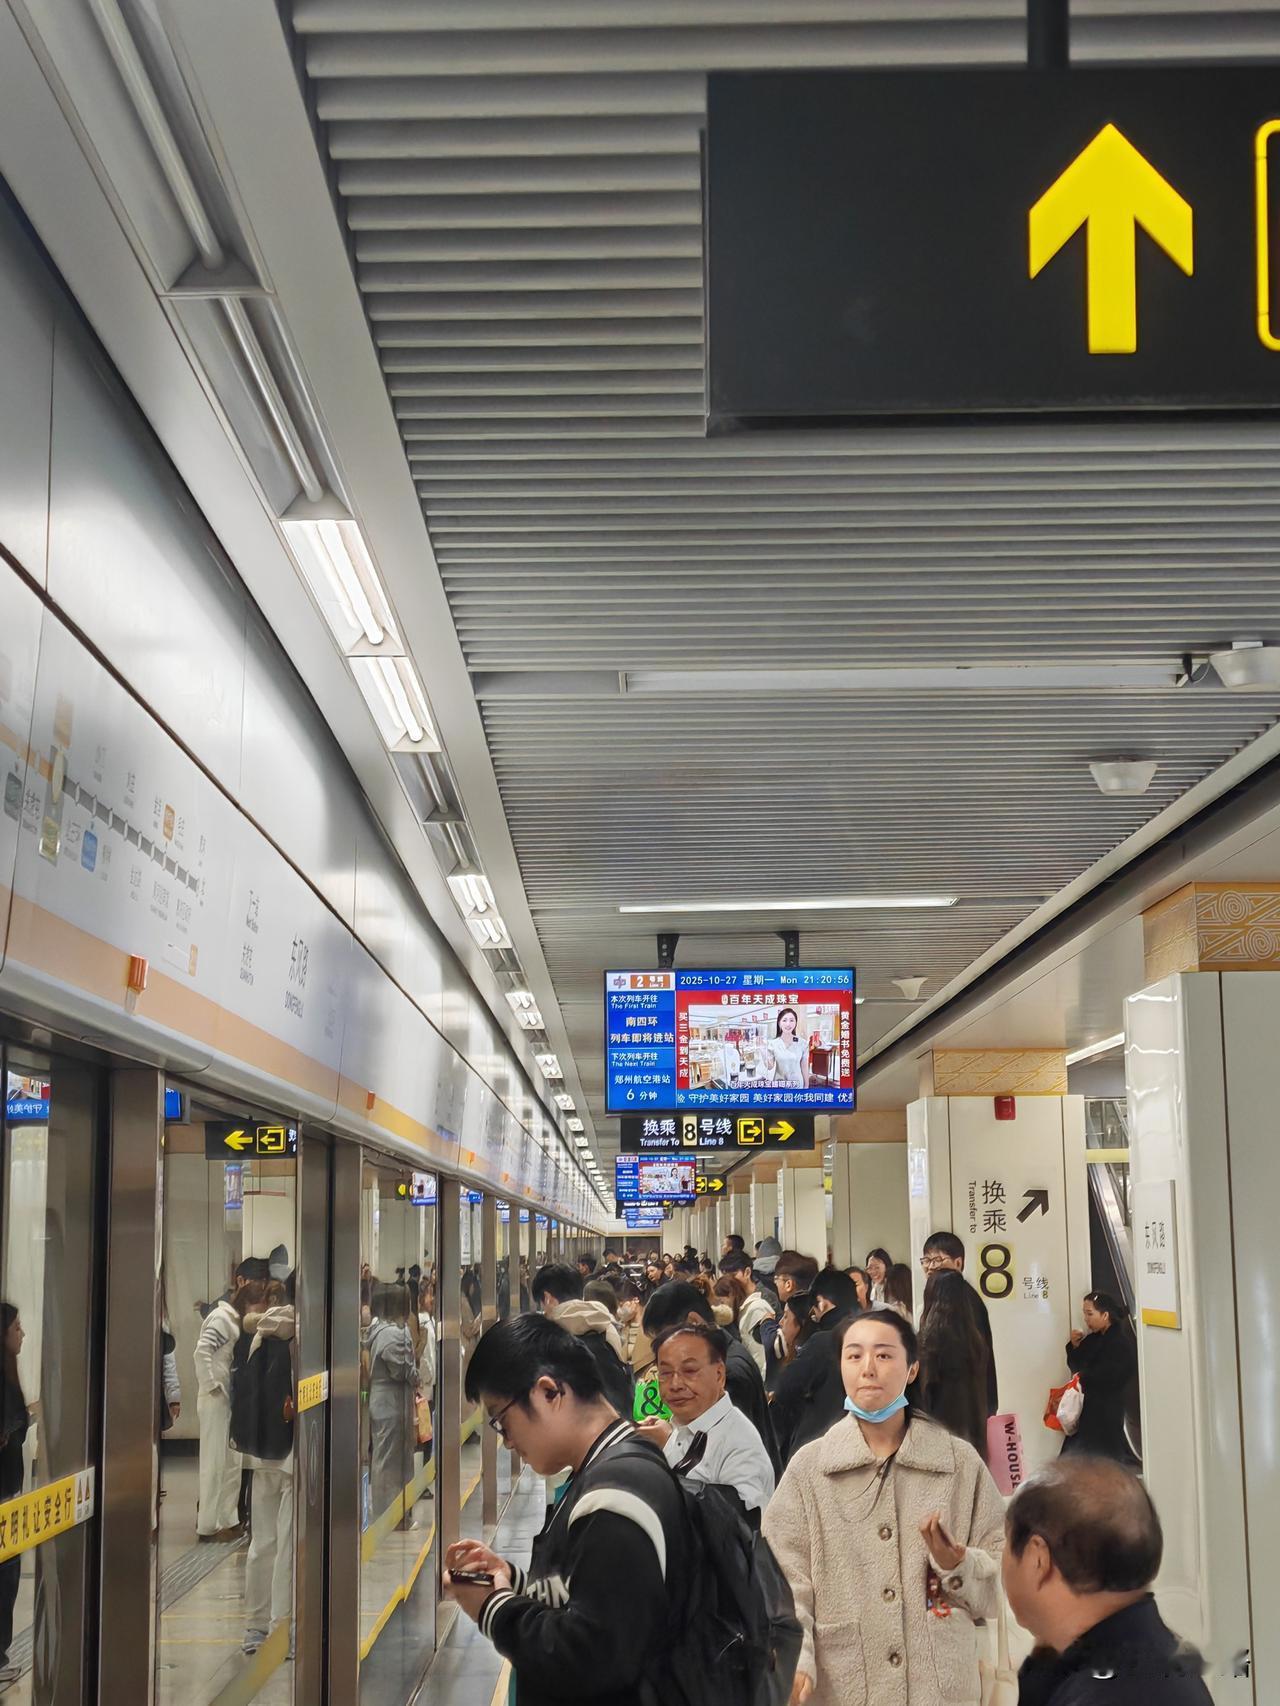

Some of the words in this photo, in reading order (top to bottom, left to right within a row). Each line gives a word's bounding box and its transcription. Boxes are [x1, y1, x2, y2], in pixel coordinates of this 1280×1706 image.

[637, 976, 644, 988] 2
[681, 976, 737, 985] 2025-10-27
[742, 975, 775, 986] 星期一
[780, 976, 798, 984] Mon
[804, 975, 850, 984] 21:20:56
[611, 994, 658, 1003] 本次列车开往
[625, 1016, 658, 1027] 南四环
[610, 1033, 674, 1044] 列车即将进站
[611, 1052, 658, 1061] 下次列车开往
[614, 1074, 671, 1084] 郑州航空港站
[626, 1088, 635, 1101] 6
[639, 1091, 658, 1101] 分钟
[689, 1093, 750, 1104] 守护美好家园
[753, 1092, 834, 1103] 美好家园你我同建
[643, 1119, 676, 1136] 换乘
[684, 1123, 696, 1141] 8
[699, 1118, 732, 1136] 号线
[640, 1138, 669, 1146] Transfer
[670, 1138, 680, 1146] To
[699, 1138, 717, 1146] Line
[968, 1181, 978, 1221] Transfer
[981, 1180, 1007, 1234] 换乘
[969, 1224, 977, 1234] to
[980, 1244, 1013, 1299] 8
[1022, 1276, 1050, 1291] 号线
[1042, 1290, 1049, 1299] 8
